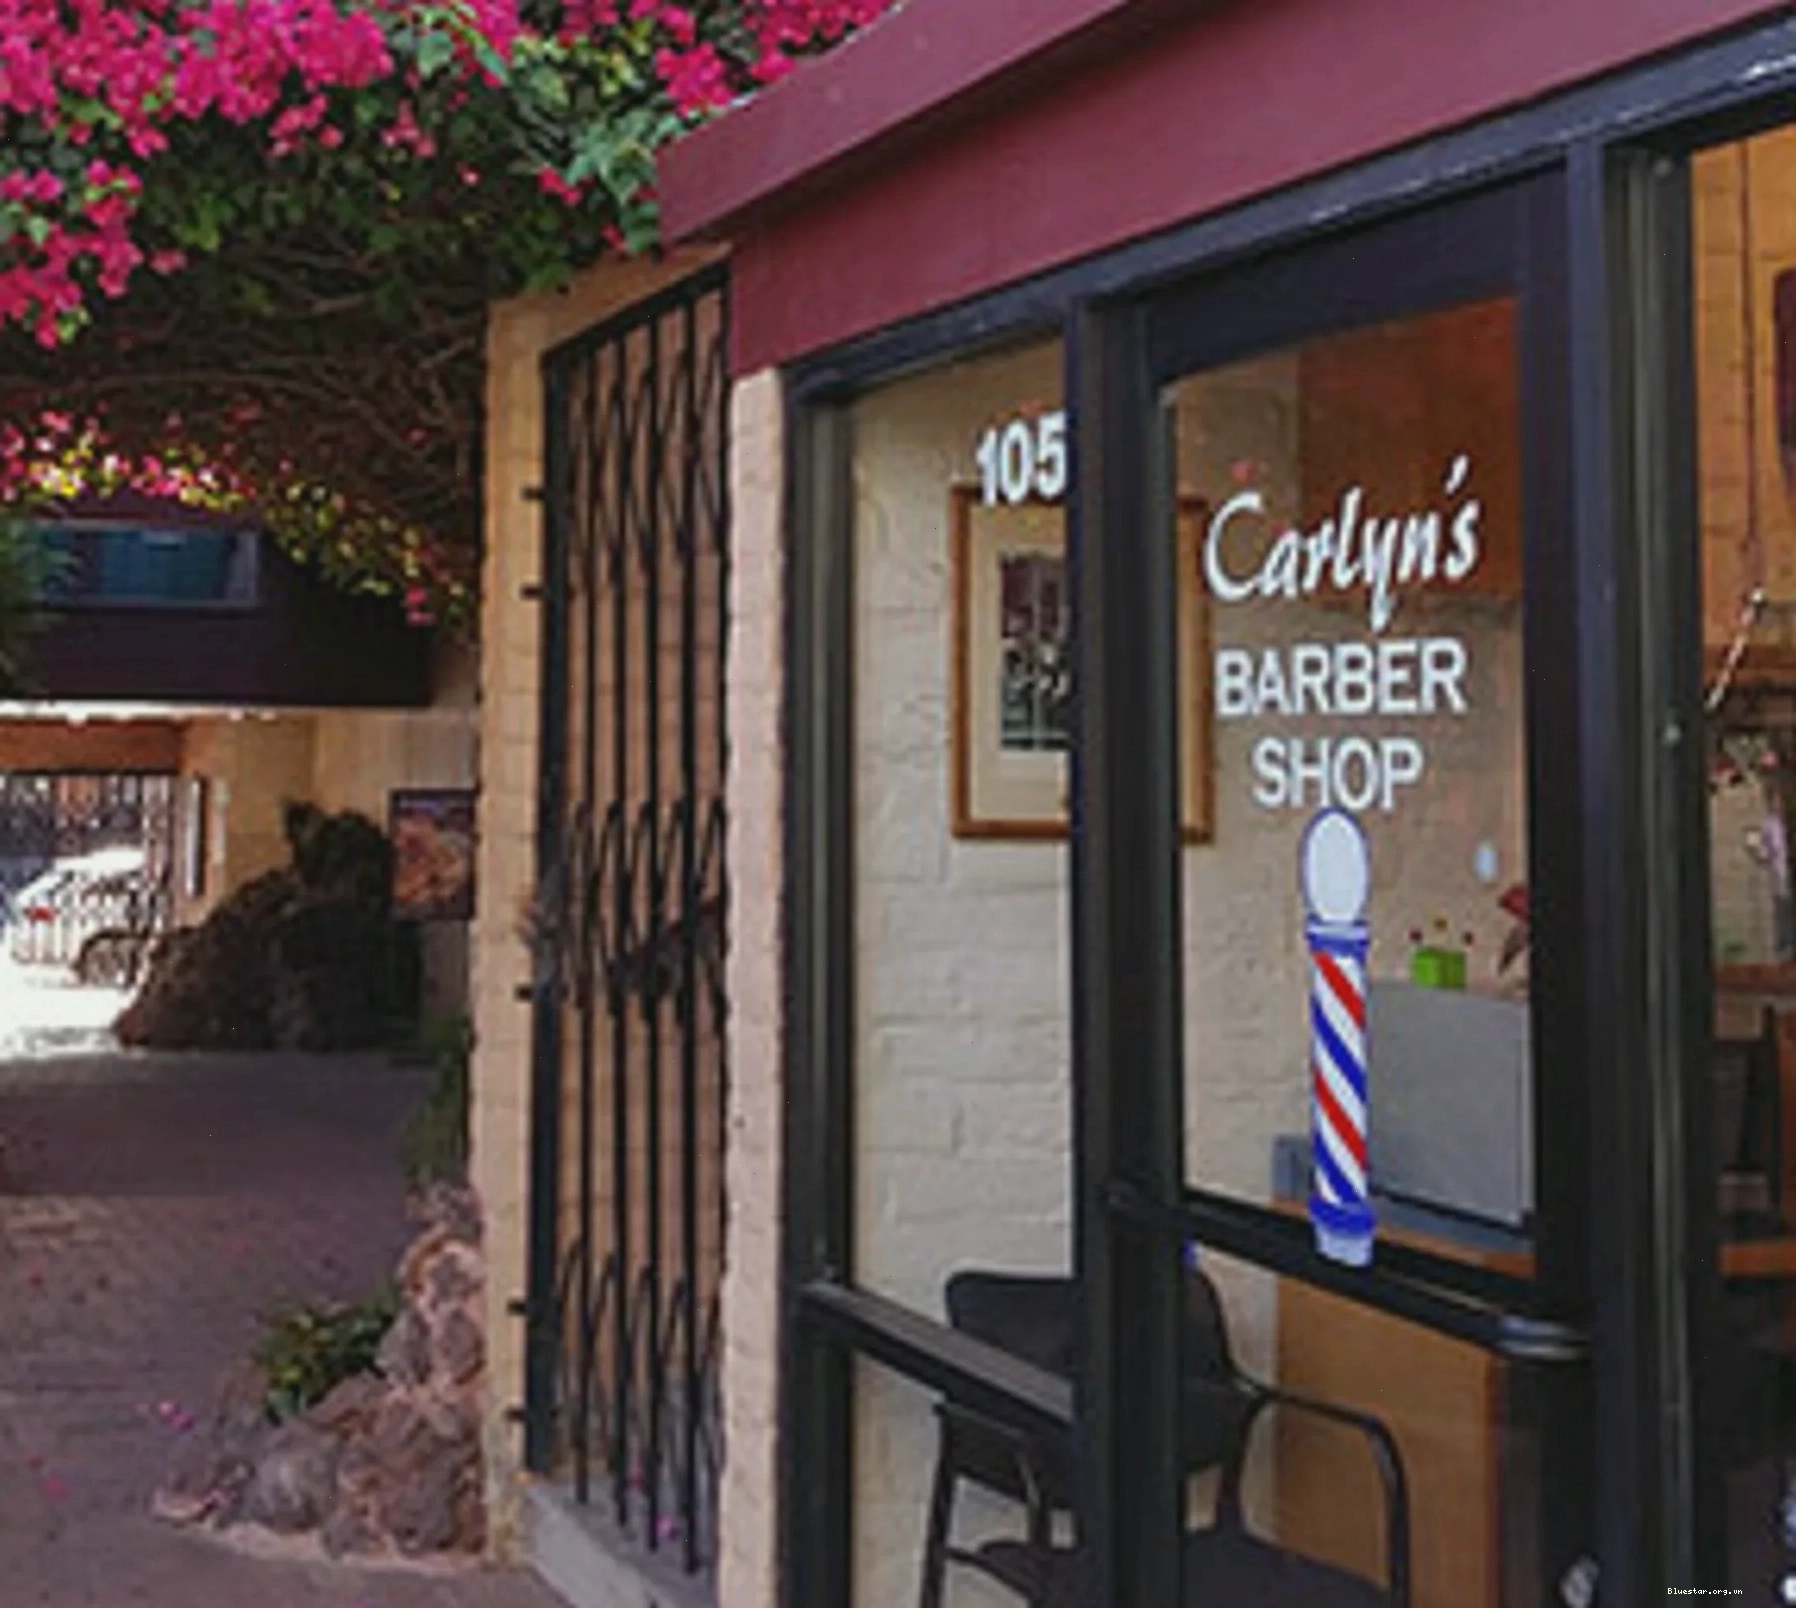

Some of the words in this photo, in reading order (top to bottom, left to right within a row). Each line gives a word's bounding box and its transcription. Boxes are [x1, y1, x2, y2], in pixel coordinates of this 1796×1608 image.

[975, 410, 1067, 507] 105
[1205, 454, 1480, 631] Carlyn's
[1214, 637, 1467, 717] BARBER
[1252, 736, 1424, 812] SHOP
